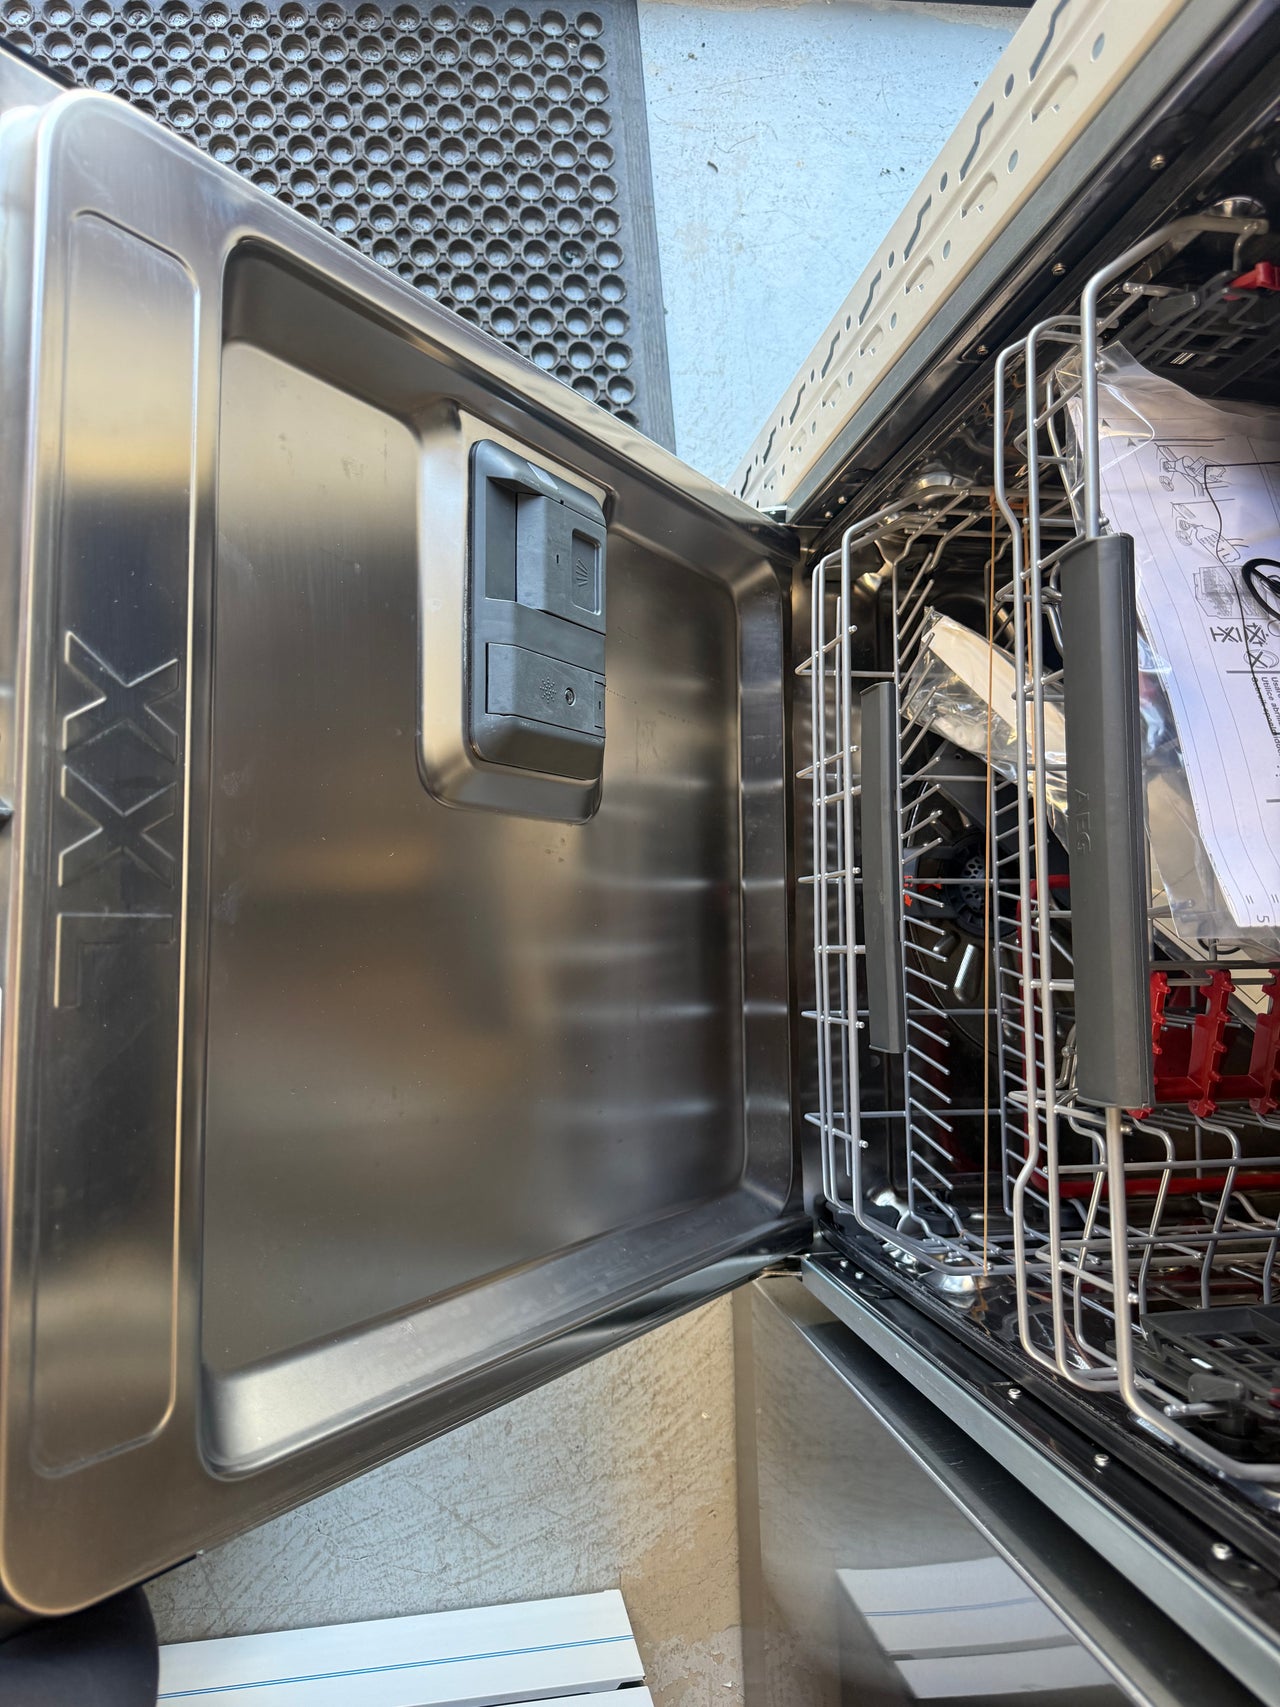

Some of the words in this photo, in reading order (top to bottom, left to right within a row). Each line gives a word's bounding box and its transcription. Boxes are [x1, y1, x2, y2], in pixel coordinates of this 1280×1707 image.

[54, 631, 180, 1008] XXL
[1073, 787, 1092, 854] AEG
[1256, 914, 1270, 923] 5
